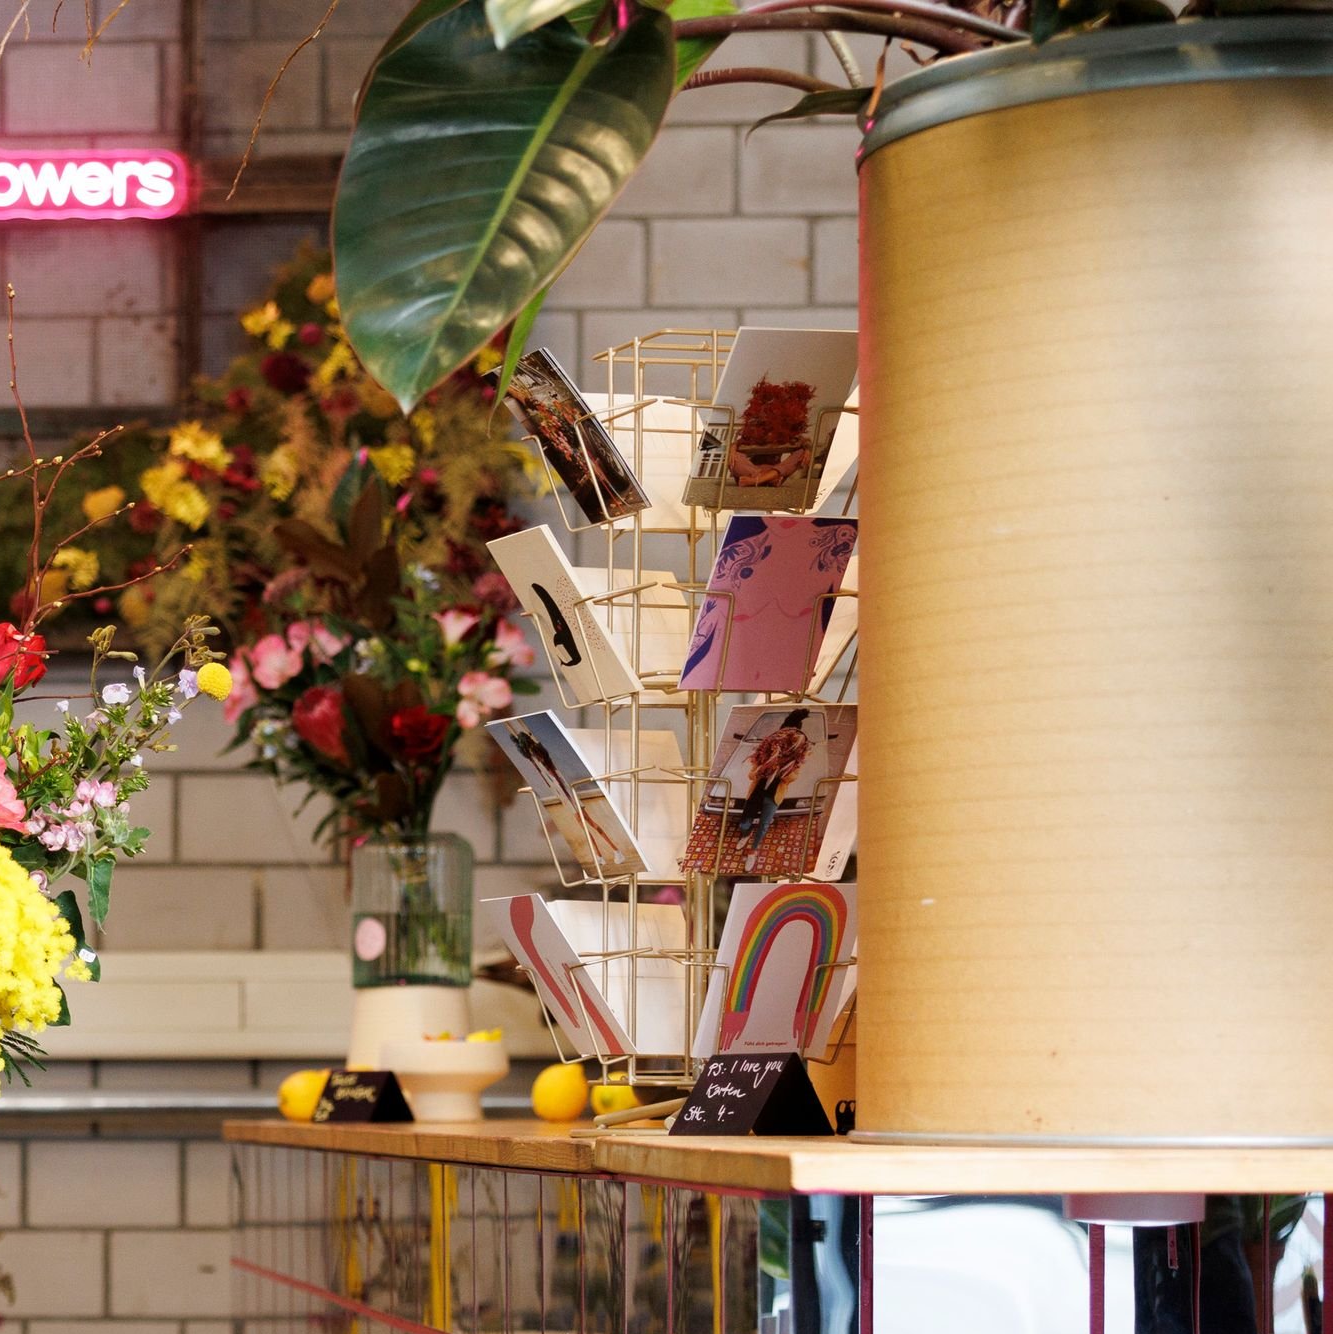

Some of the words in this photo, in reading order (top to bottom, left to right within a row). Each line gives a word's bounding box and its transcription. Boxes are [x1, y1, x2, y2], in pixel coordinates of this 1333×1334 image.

[739, 1060, 761, 1073] love
[753, 1060, 784, 1089] you
[705, 1082, 746, 1099] Karten
